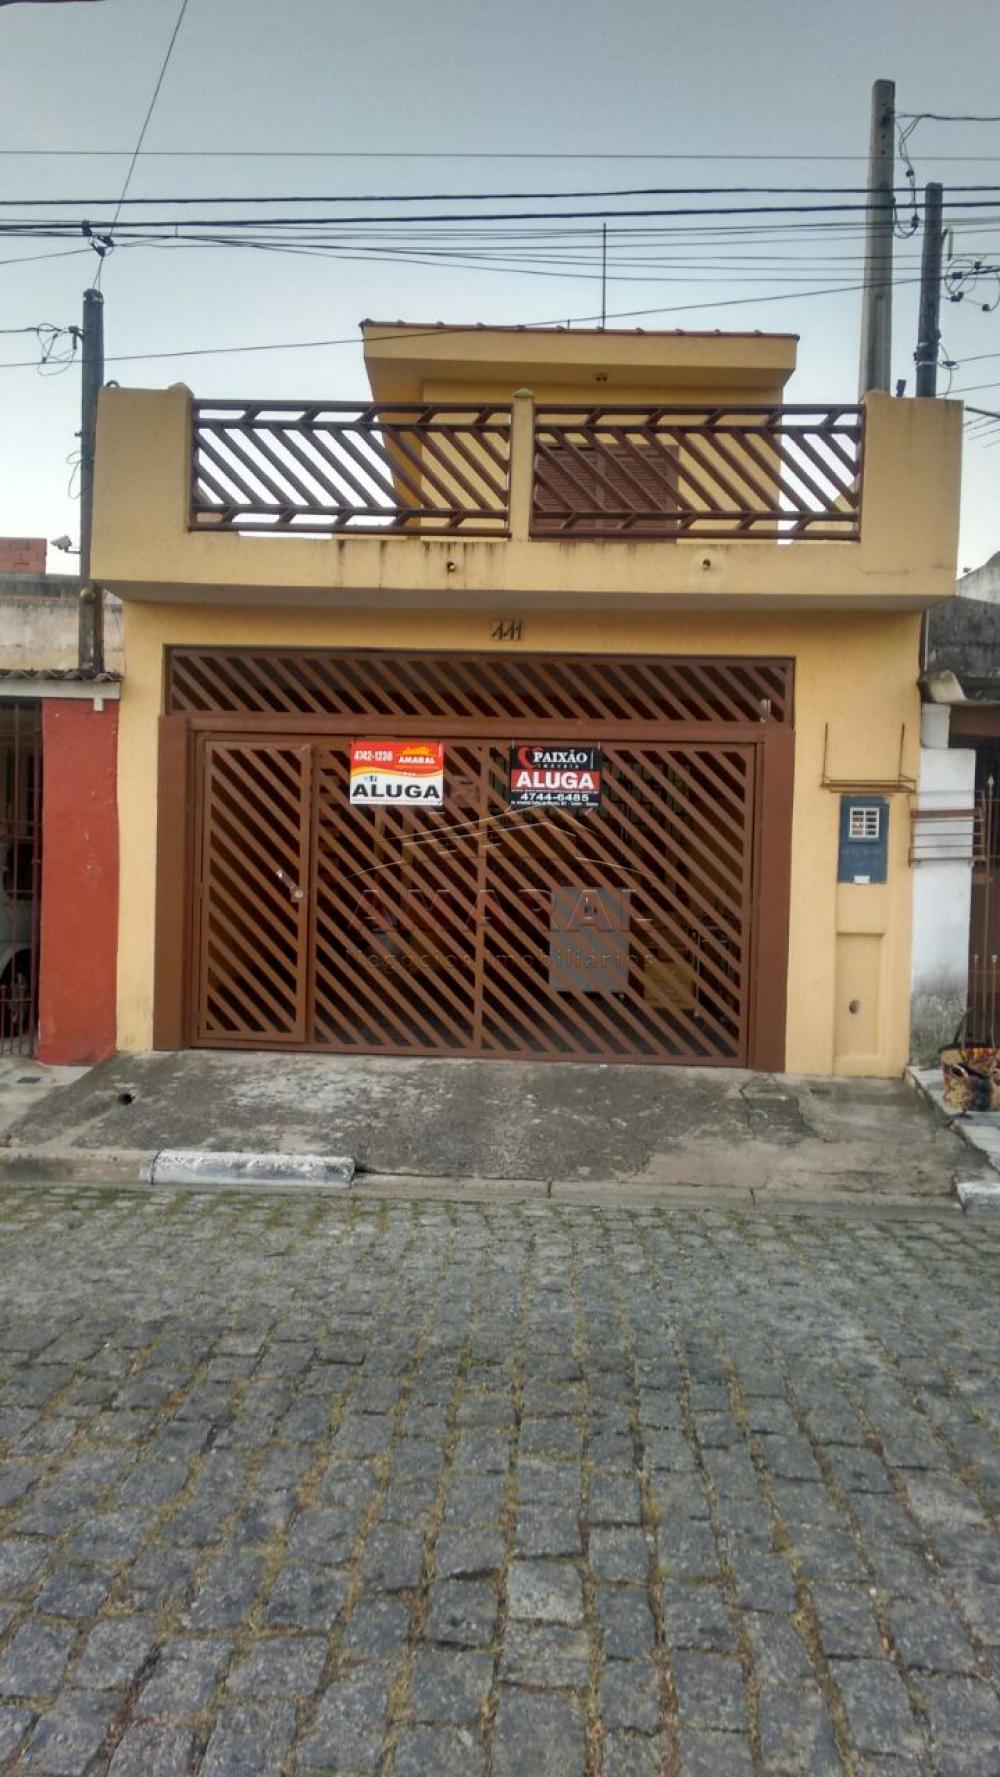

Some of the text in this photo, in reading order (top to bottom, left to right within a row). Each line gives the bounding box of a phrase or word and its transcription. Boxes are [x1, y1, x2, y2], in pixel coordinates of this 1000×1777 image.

[491, 621, 522, 640] 441
[399, 756, 436, 764] AMARAL
[533, 749, 588, 763] PAIXÃO
[516, 771, 594, 789] ALUGA
[352, 784, 440, 799] ALUGA
[520, 792, 589, 802] 4744-6485
